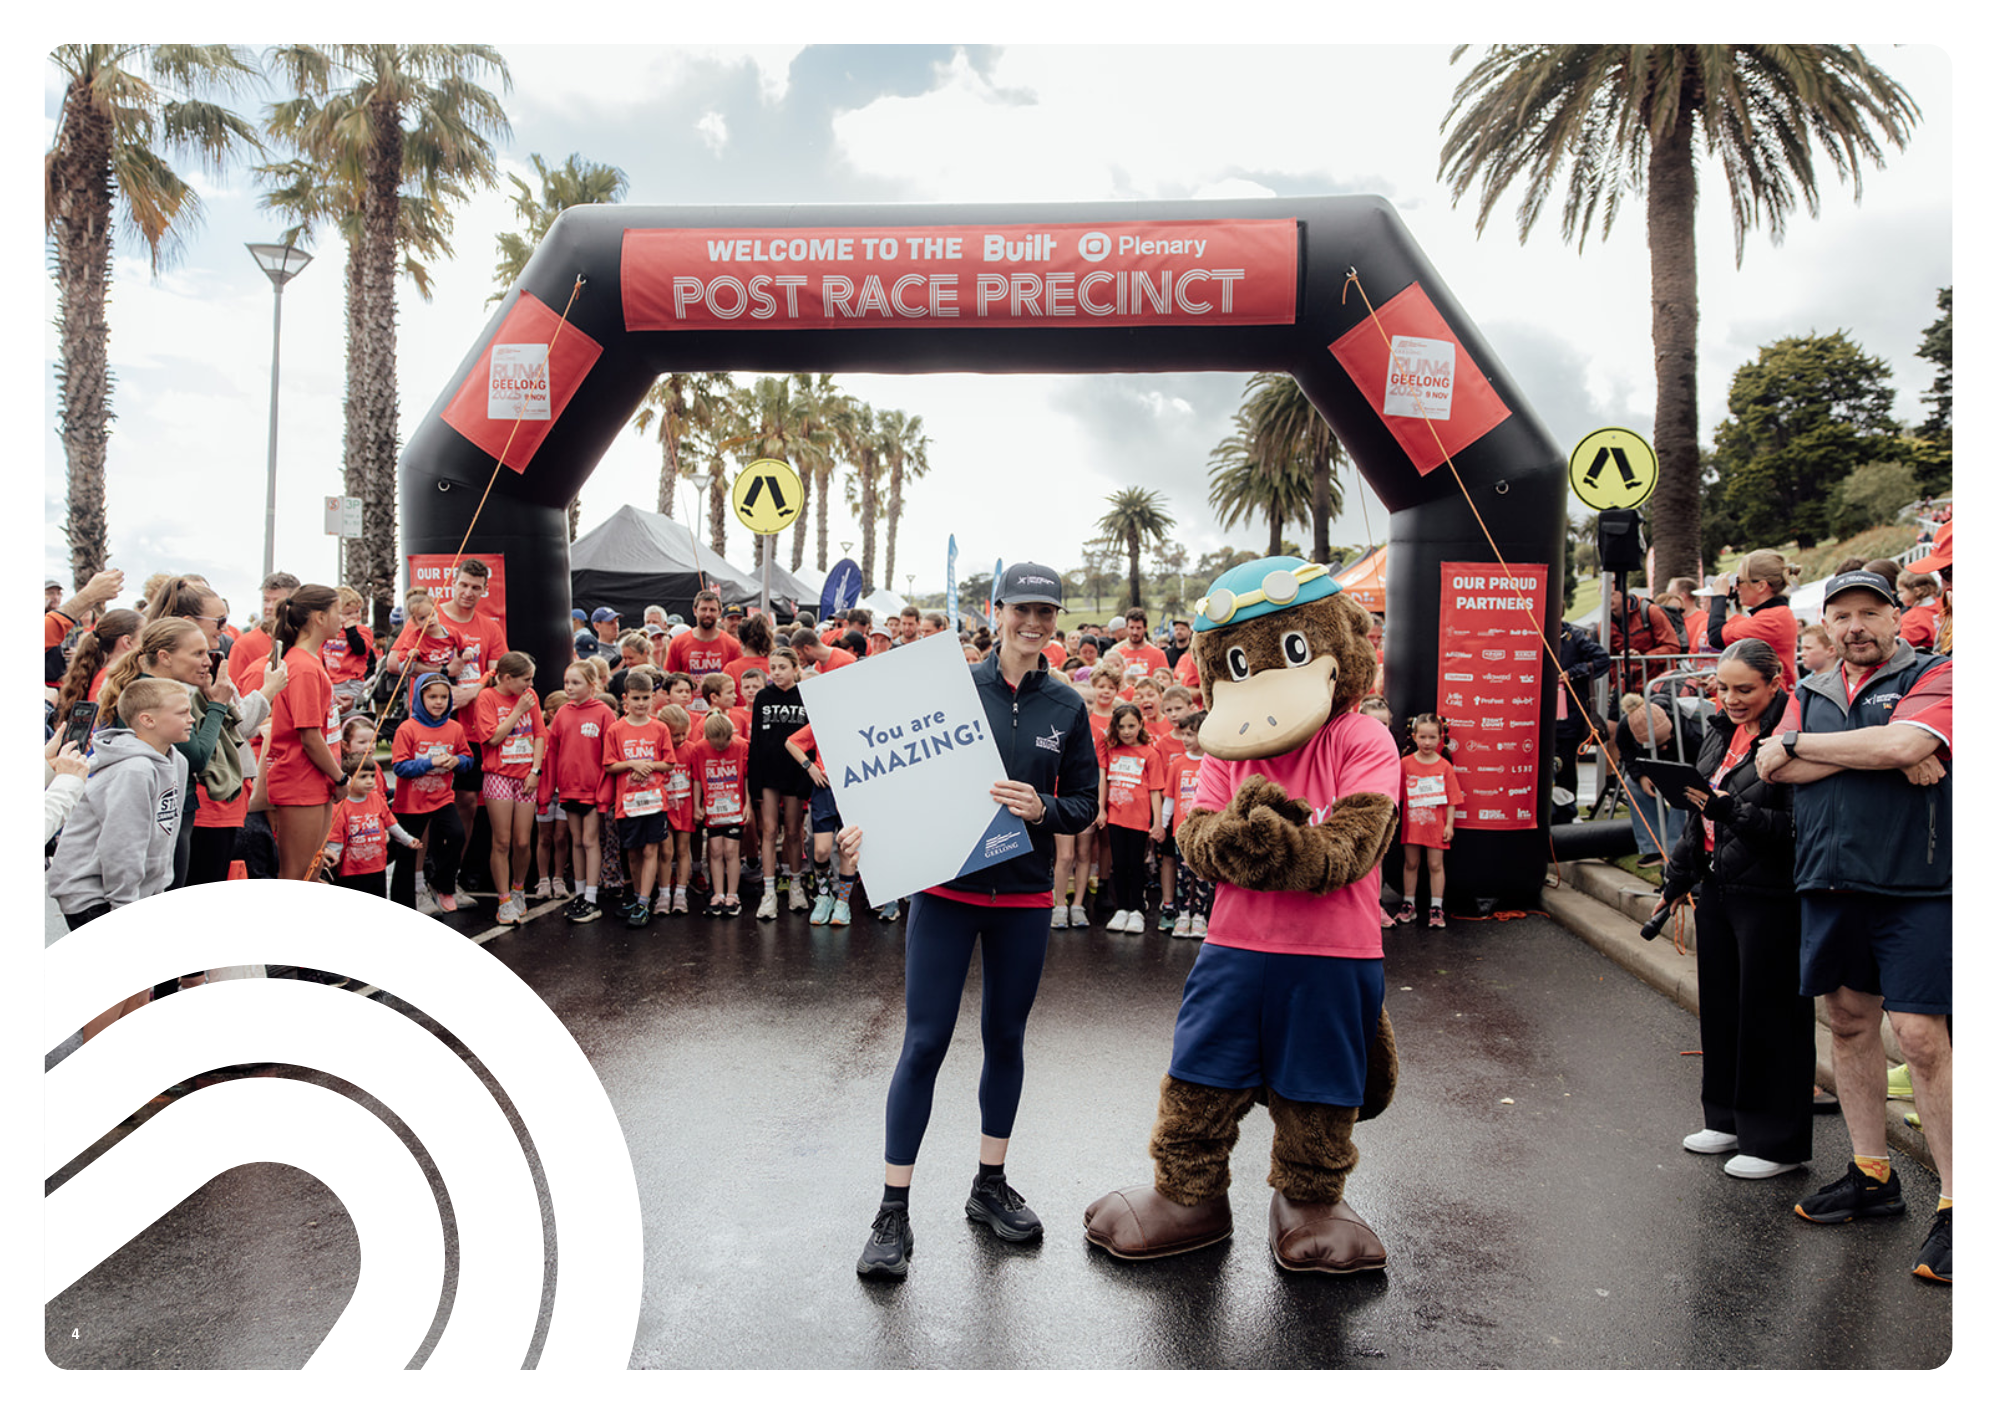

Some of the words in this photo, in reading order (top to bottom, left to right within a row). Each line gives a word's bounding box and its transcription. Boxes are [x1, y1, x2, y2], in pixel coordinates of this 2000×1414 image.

[707, 238, 854, 262] WELCOME
[861, 238, 898, 260] TO
[906, 237, 963, 260] THE
[983, 233, 1057, 262] Built
[1118, 236, 1207, 258] Plenary
[673, 274, 808, 320] POST
[822, 274, 960, 318] RACE
[976, 268, 1245, 316] PRECINCT
[492, 378, 546, 390] GEELONG
[1391, 373, 1450, 388] GEELONG
[346, 500, 360, 510] 3P
[417, 567, 440, 580] OUR
[1453, 577, 1485, 590] OUR
[1489, 577, 1537, 590] PROUD
[1456, 597, 1534, 610] PARTNERS
[689, 658, 722, 670] RUN4
[762, 704, 805, 716] STATE
[858, 725, 904, 748] You
[910, 711, 945, 732] are
[624, 746, 654, 758] RUN4
[844, 720, 984, 788] AMAZING!
[706, 765, 738, 778] RUN4
